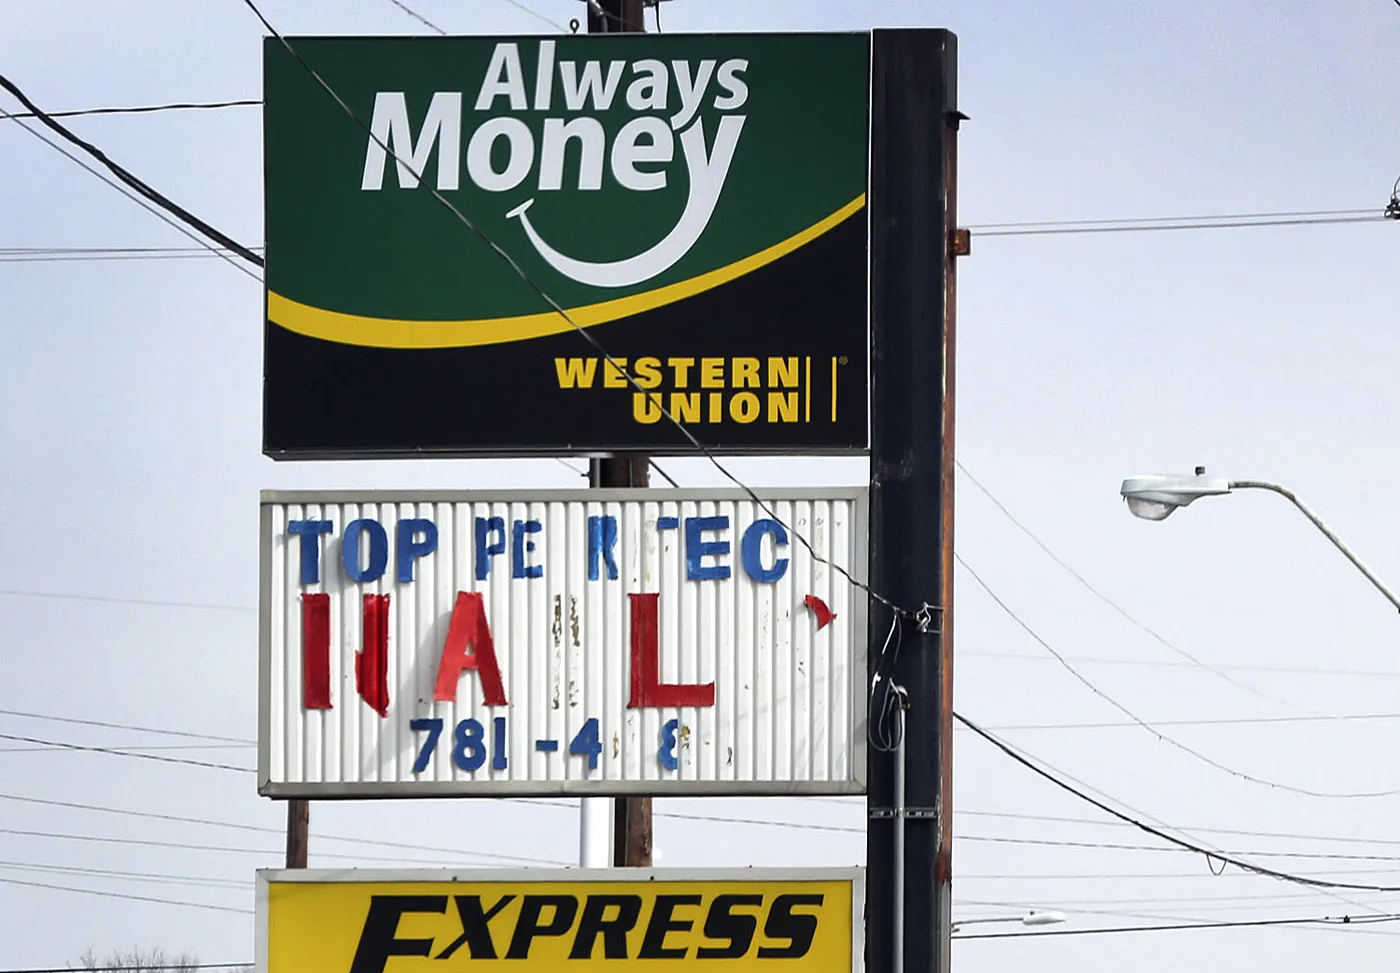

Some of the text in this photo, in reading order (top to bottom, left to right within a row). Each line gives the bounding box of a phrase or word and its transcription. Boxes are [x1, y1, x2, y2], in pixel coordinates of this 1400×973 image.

[474, 40, 750, 130] Always
[361, 92, 747, 287] Money
[554, 356, 799, 389] WESTERN
[633, 392, 799, 424] UNION
[288, 518, 438, 583] TOP
